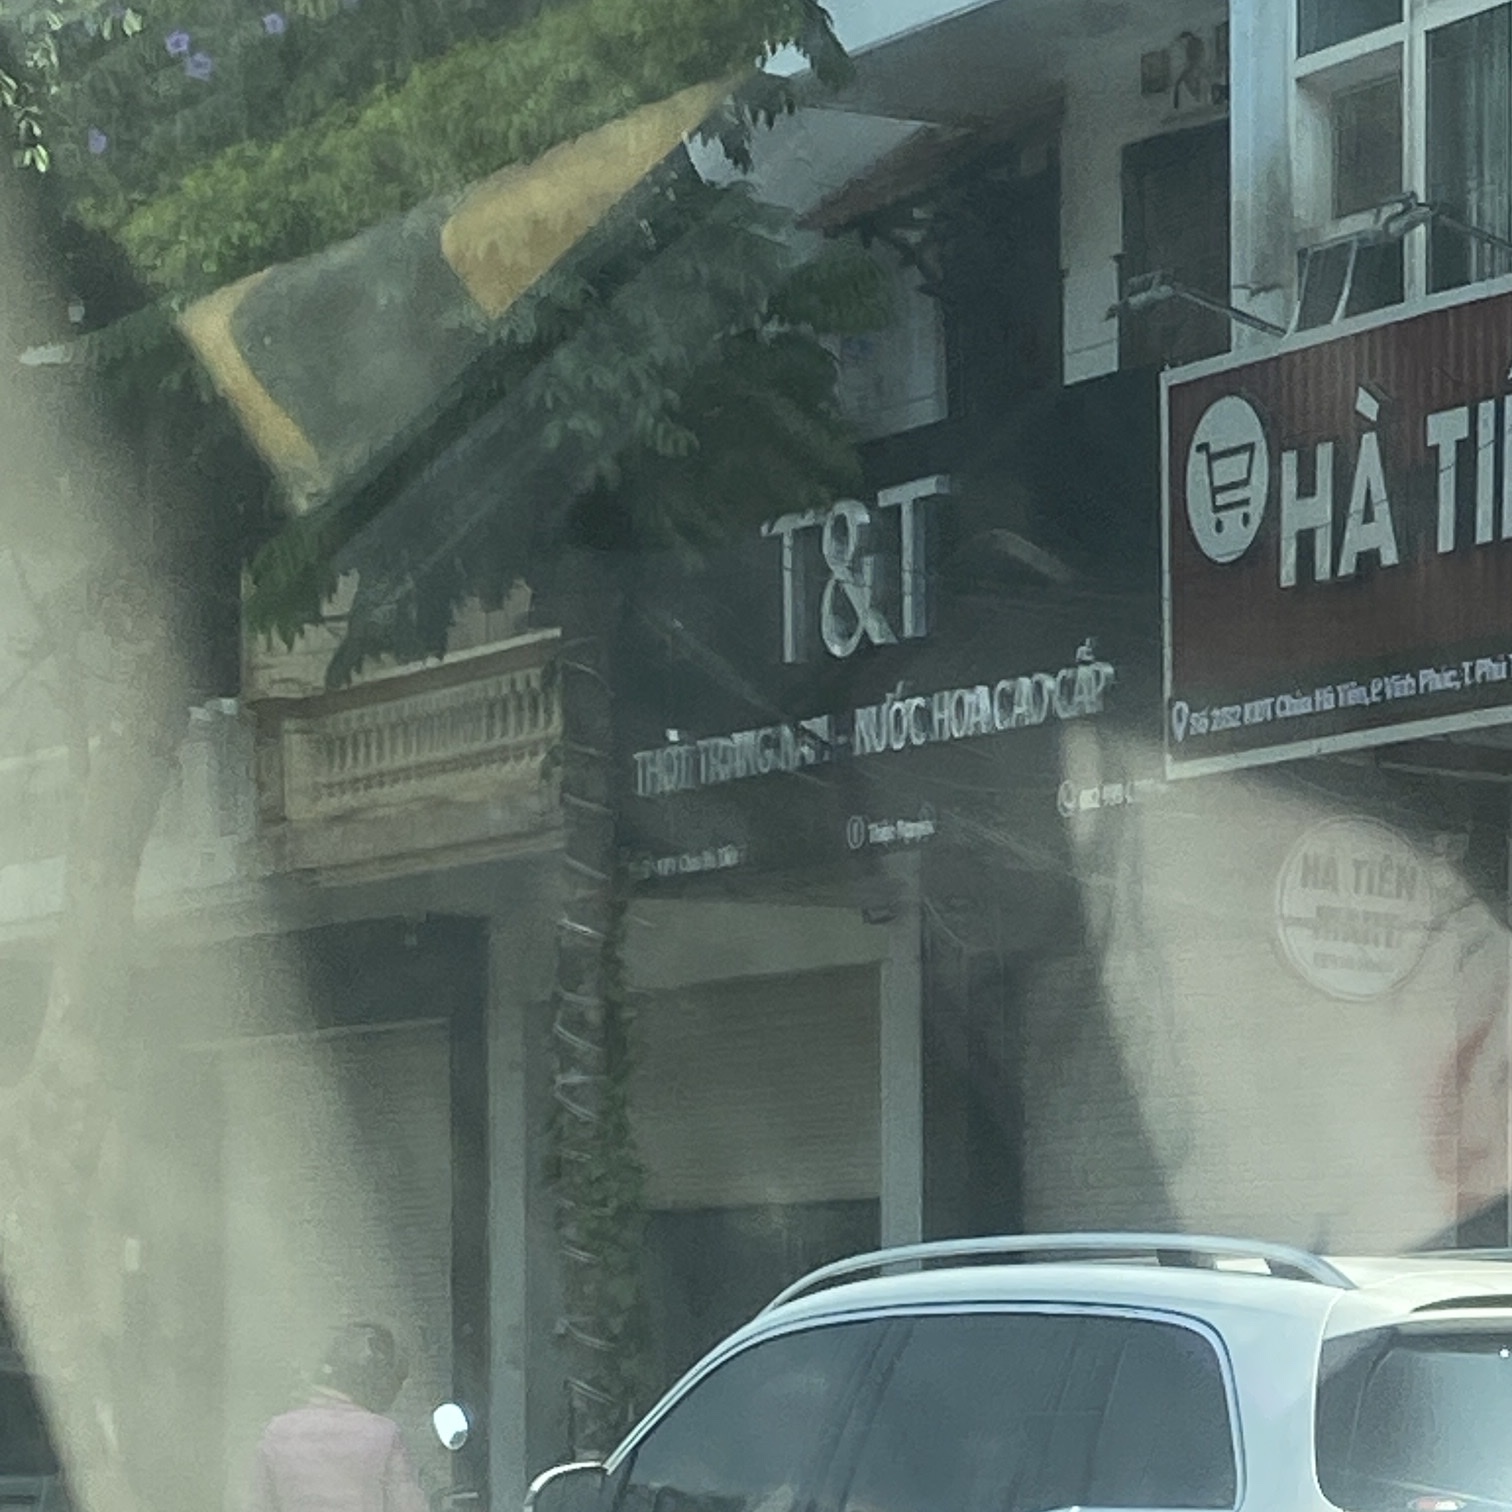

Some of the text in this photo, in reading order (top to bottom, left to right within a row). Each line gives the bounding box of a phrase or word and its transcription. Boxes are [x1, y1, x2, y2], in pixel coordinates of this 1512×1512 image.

[760, 475, 948, 662] T&T
[1280, 386, 1399, 587] HÀ
[853, 680, 926, 756] NƯỚC
